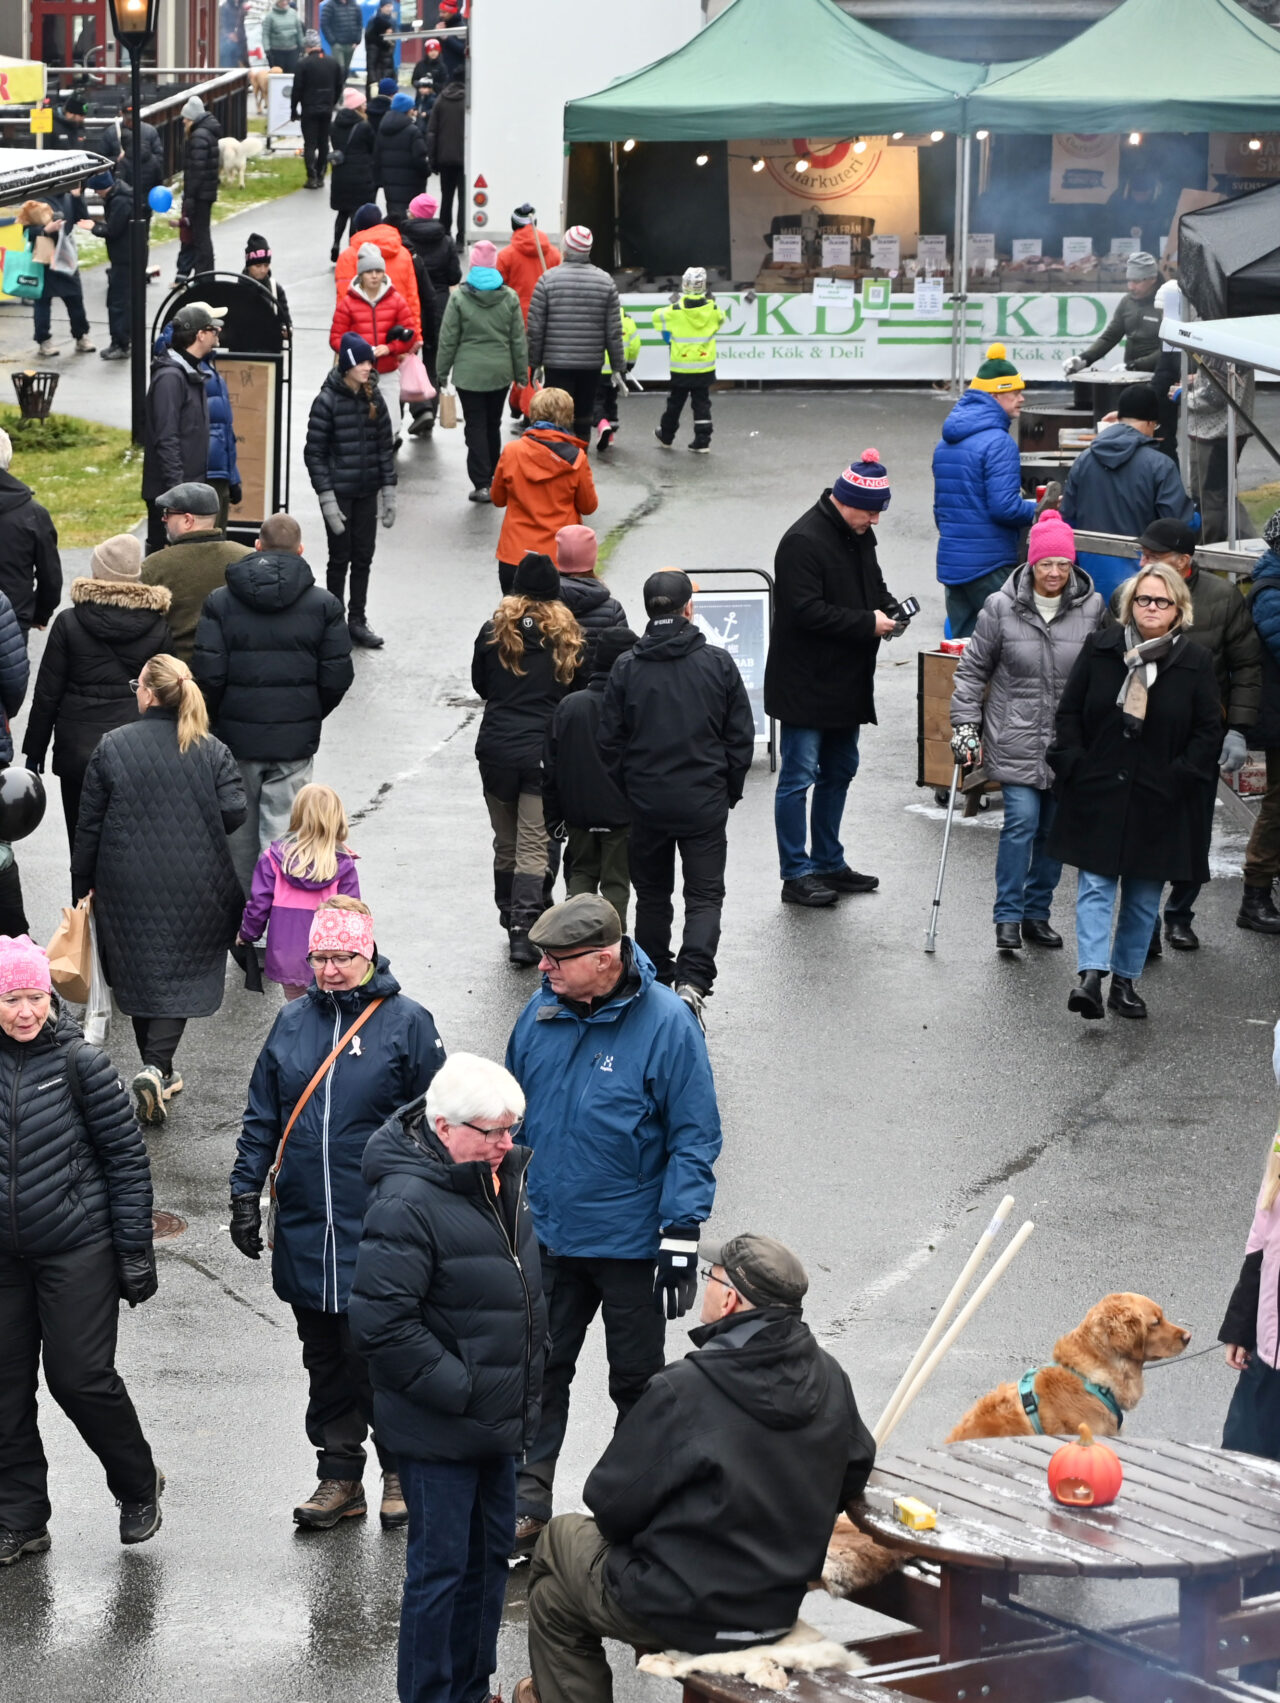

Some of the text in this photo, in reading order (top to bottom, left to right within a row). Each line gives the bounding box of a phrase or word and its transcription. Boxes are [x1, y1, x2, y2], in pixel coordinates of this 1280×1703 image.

[771, 345, 804, 360] Kök
[809, 345, 823, 360] &
[829, 345, 864, 360] Deli
[1012, 347, 1045, 361] Kök
